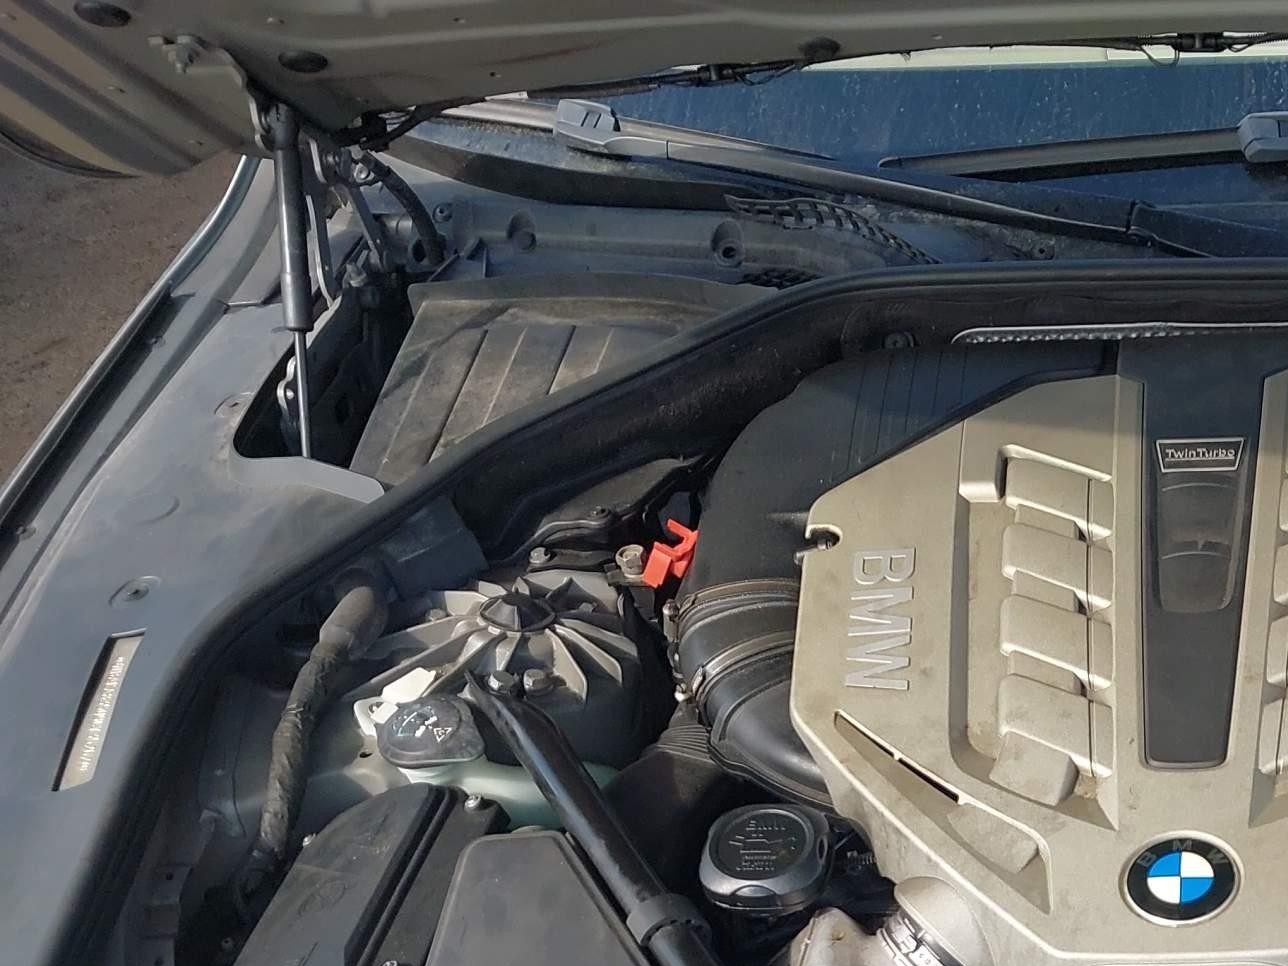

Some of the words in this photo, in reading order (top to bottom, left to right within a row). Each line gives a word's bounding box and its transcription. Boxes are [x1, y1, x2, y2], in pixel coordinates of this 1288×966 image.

[1165, 446, 1236, 459] TwinTurbo
[844, 546, 917, 690] BMW
[1136, 839, 1229, 867] BMW
